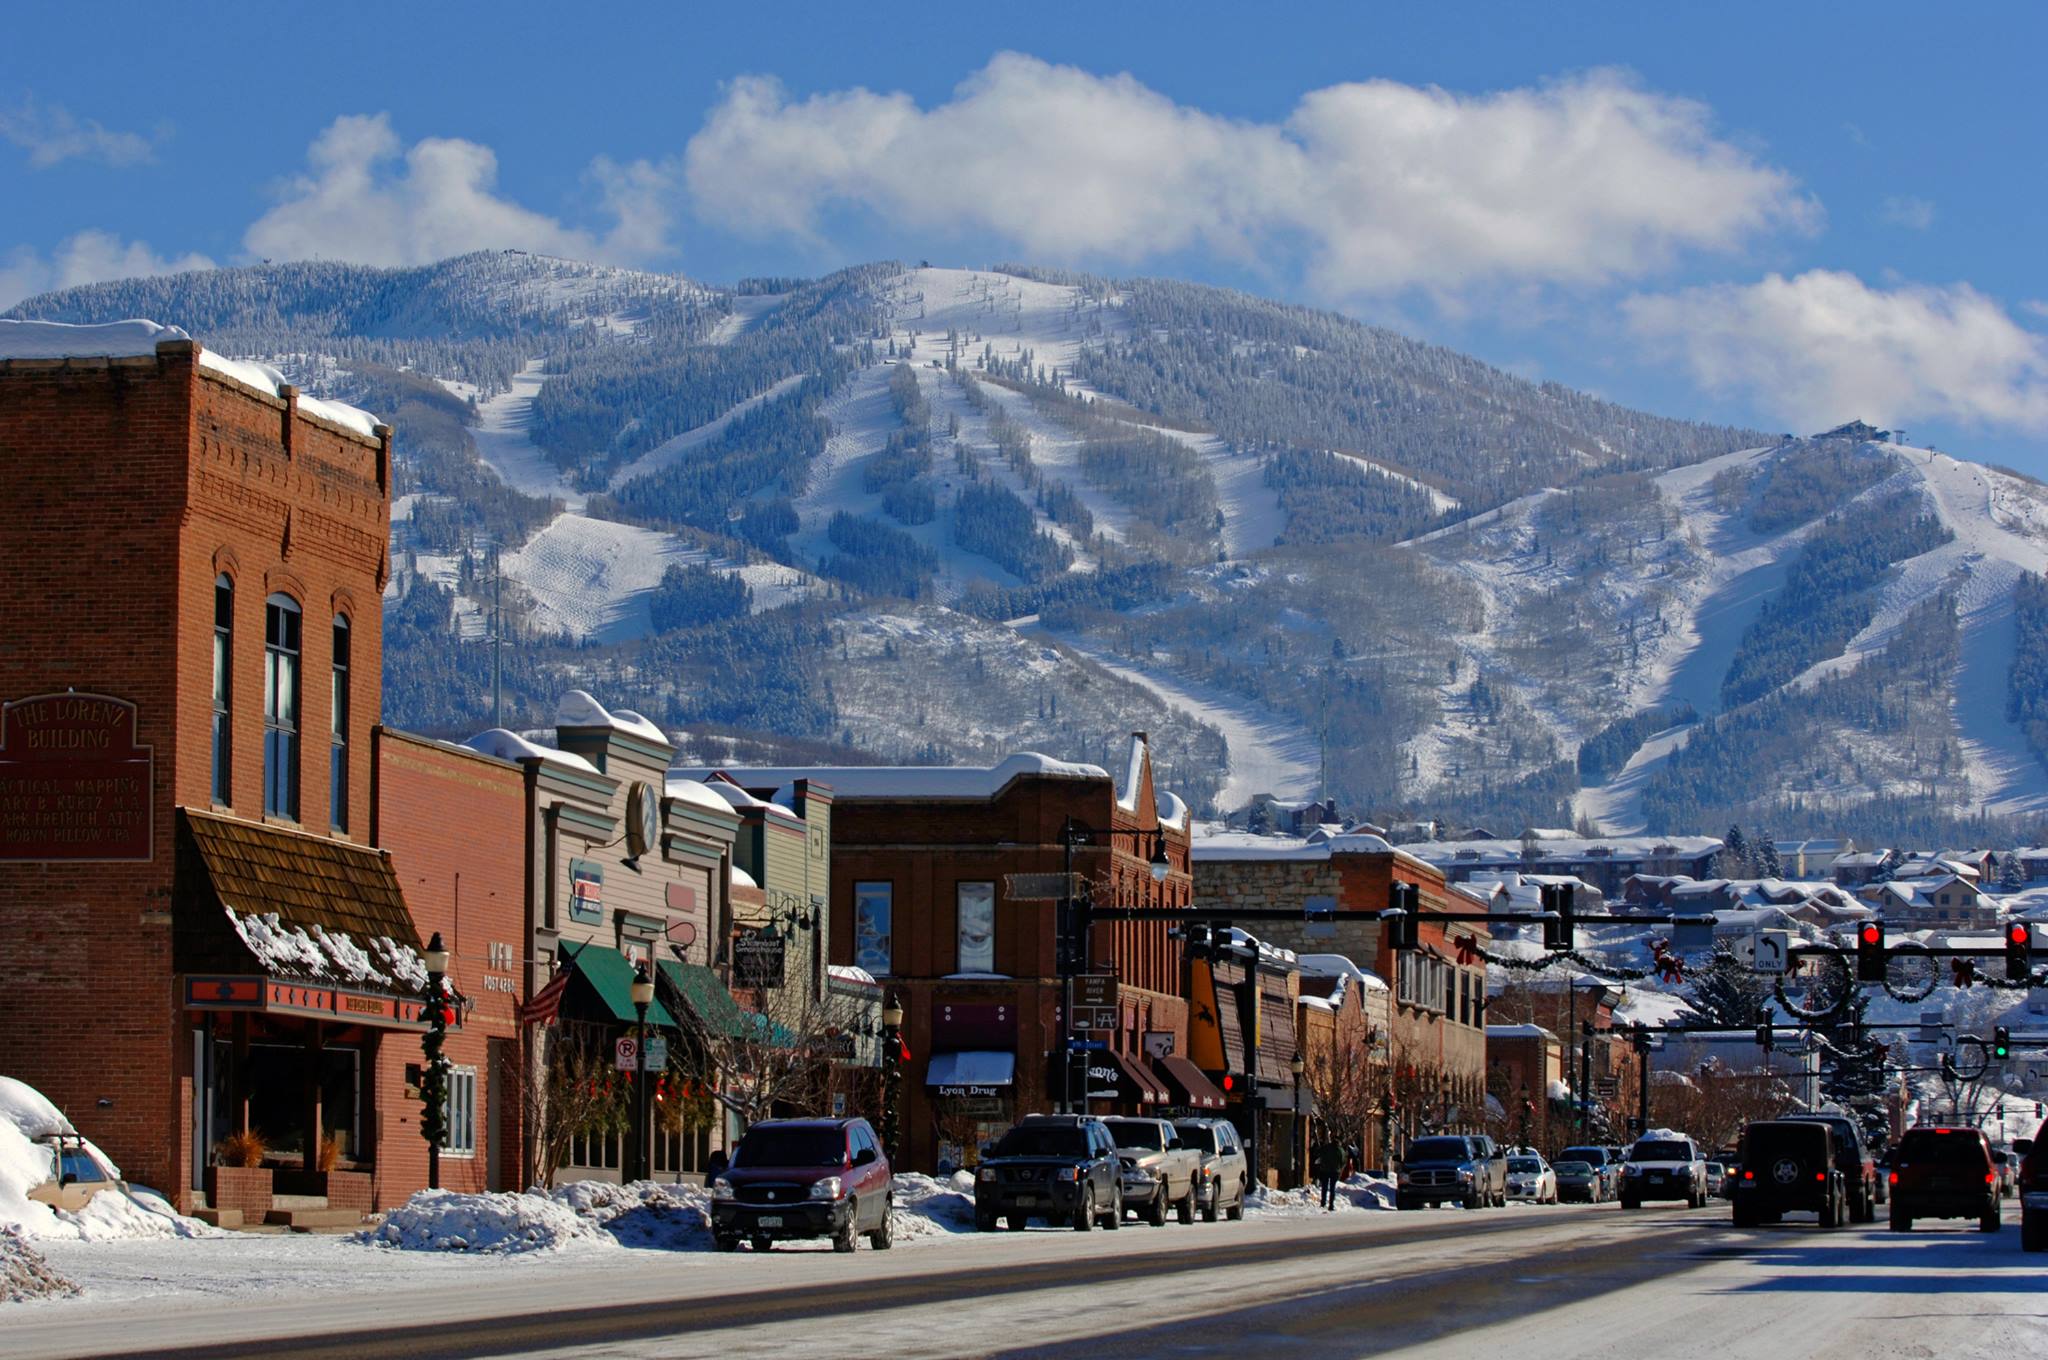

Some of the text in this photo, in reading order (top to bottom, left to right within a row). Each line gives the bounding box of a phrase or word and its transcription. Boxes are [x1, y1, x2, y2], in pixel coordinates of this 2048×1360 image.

[14, 700, 125, 728] THE LORENZ
[27, 729, 111, 749] BUILDING
[75, 777, 140, 793] MAPPING
[57, 795, 103, 810] KURTZ
[490, 942, 513, 971] VFW
[1758, 960, 1783, 969] ONLY
[484, 975, 499, 992] POST
[938, 1085, 997, 1098] Lyon Drug
